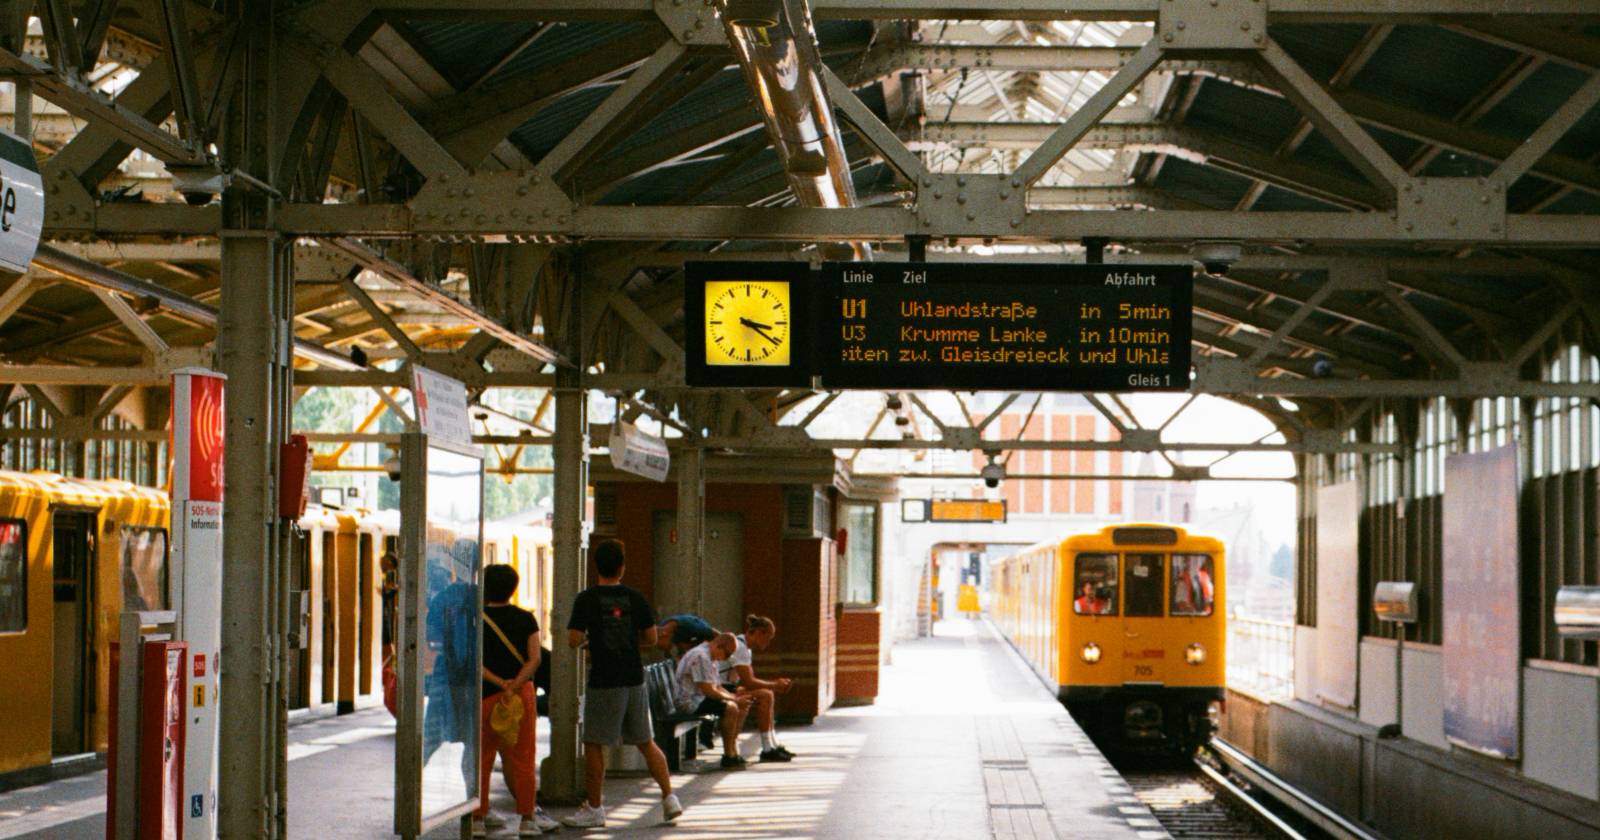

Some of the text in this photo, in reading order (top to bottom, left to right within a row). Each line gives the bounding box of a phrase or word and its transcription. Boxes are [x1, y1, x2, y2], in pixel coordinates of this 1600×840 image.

[843, 271, 1156, 286] Linie Ziel Abfahrt
[842, 299, 1170, 321] U1 Uhlandstraße in 5min
[842, 325, 1170, 343] U3 Krumme Lanke in 10min
[899, 350, 931, 362] zw.
[942, 346, 1069, 363] Gleisdreieck
[1080, 348, 1116, 363] und
[1128, 374, 1171, 386] Gleis 1
[1134, 665, 1153, 676] 705
